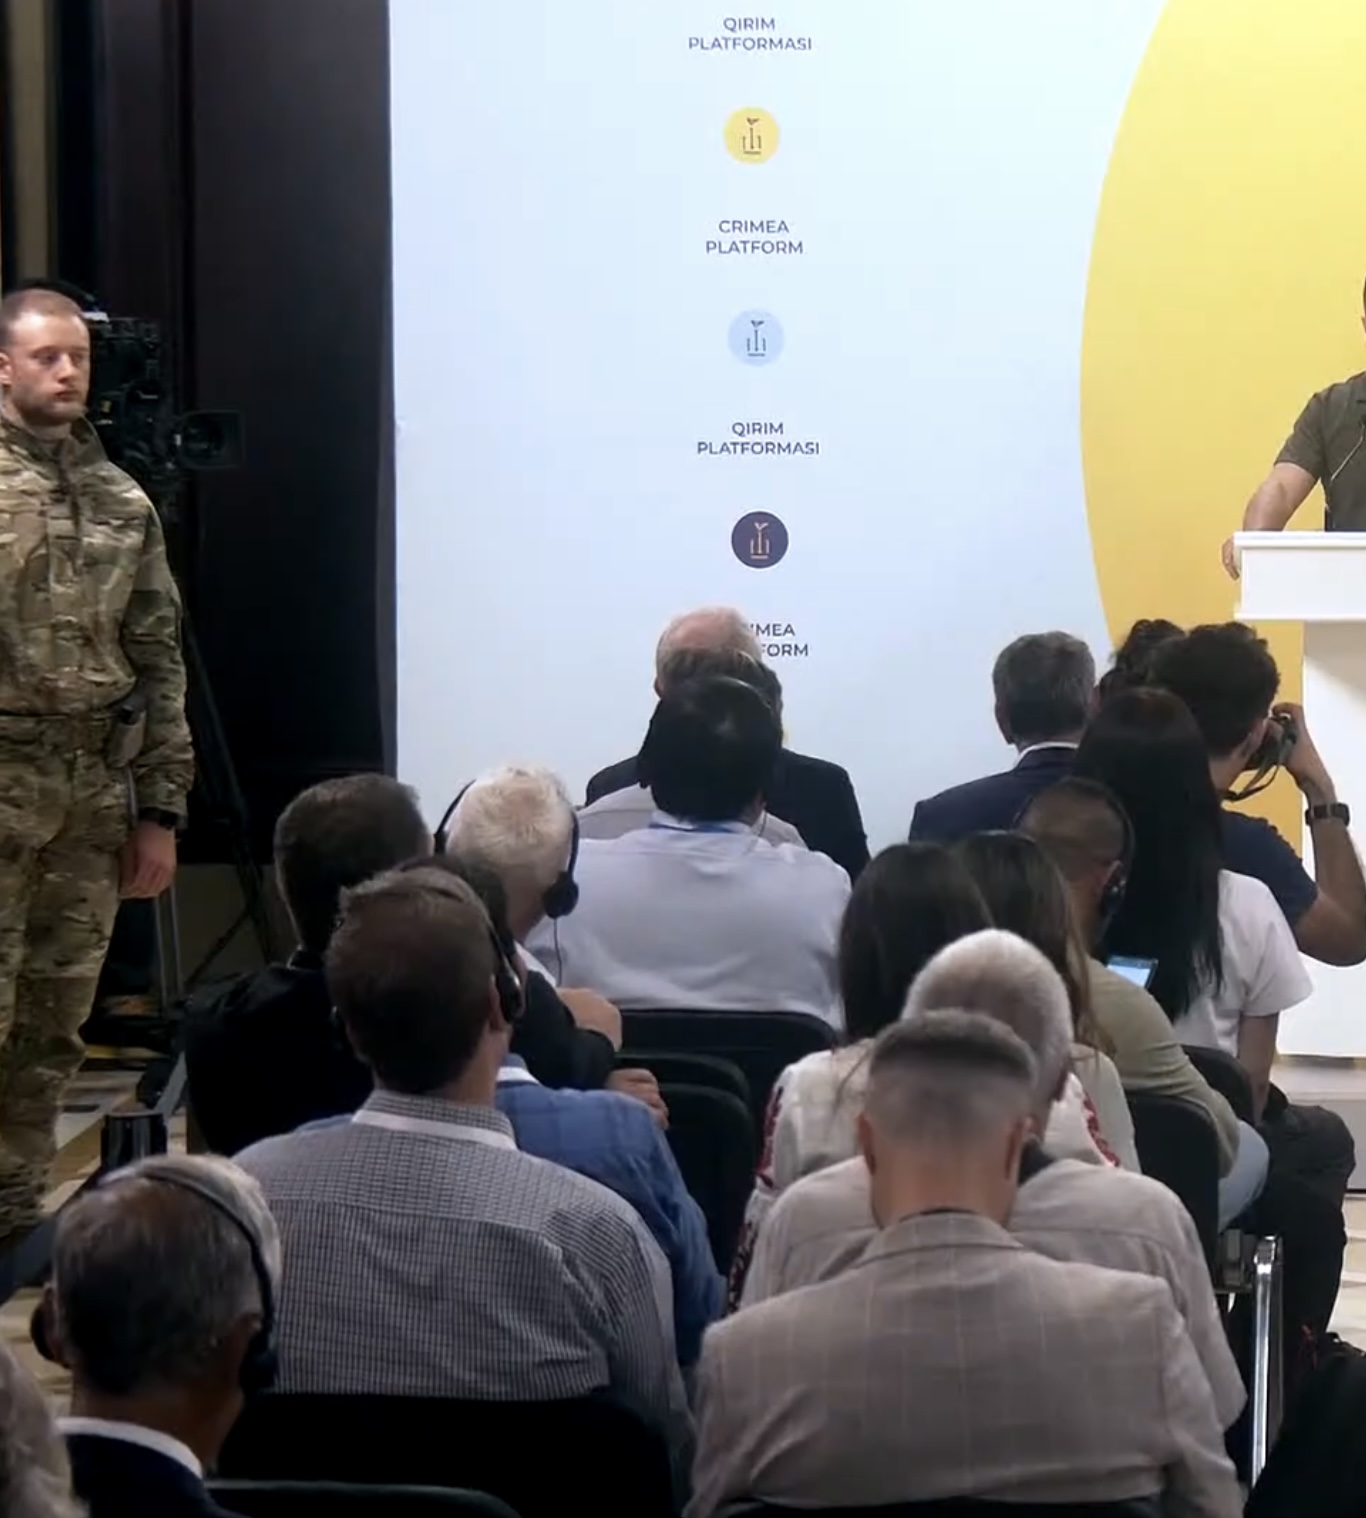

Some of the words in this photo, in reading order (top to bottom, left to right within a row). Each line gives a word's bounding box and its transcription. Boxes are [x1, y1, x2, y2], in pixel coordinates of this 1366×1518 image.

[722, 17, 776, 32] QIRIM
[688, 37, 812, 51] PLATFORMASI
[718, 219, 790, 233] CRIMEA
[705, 240, 804, 254] PLATFORM
[731, 422, 784, 437] QIRIM
[697, 441, 820, 455] PLATFORMASI
[750, 623, 796, 637] MEA
